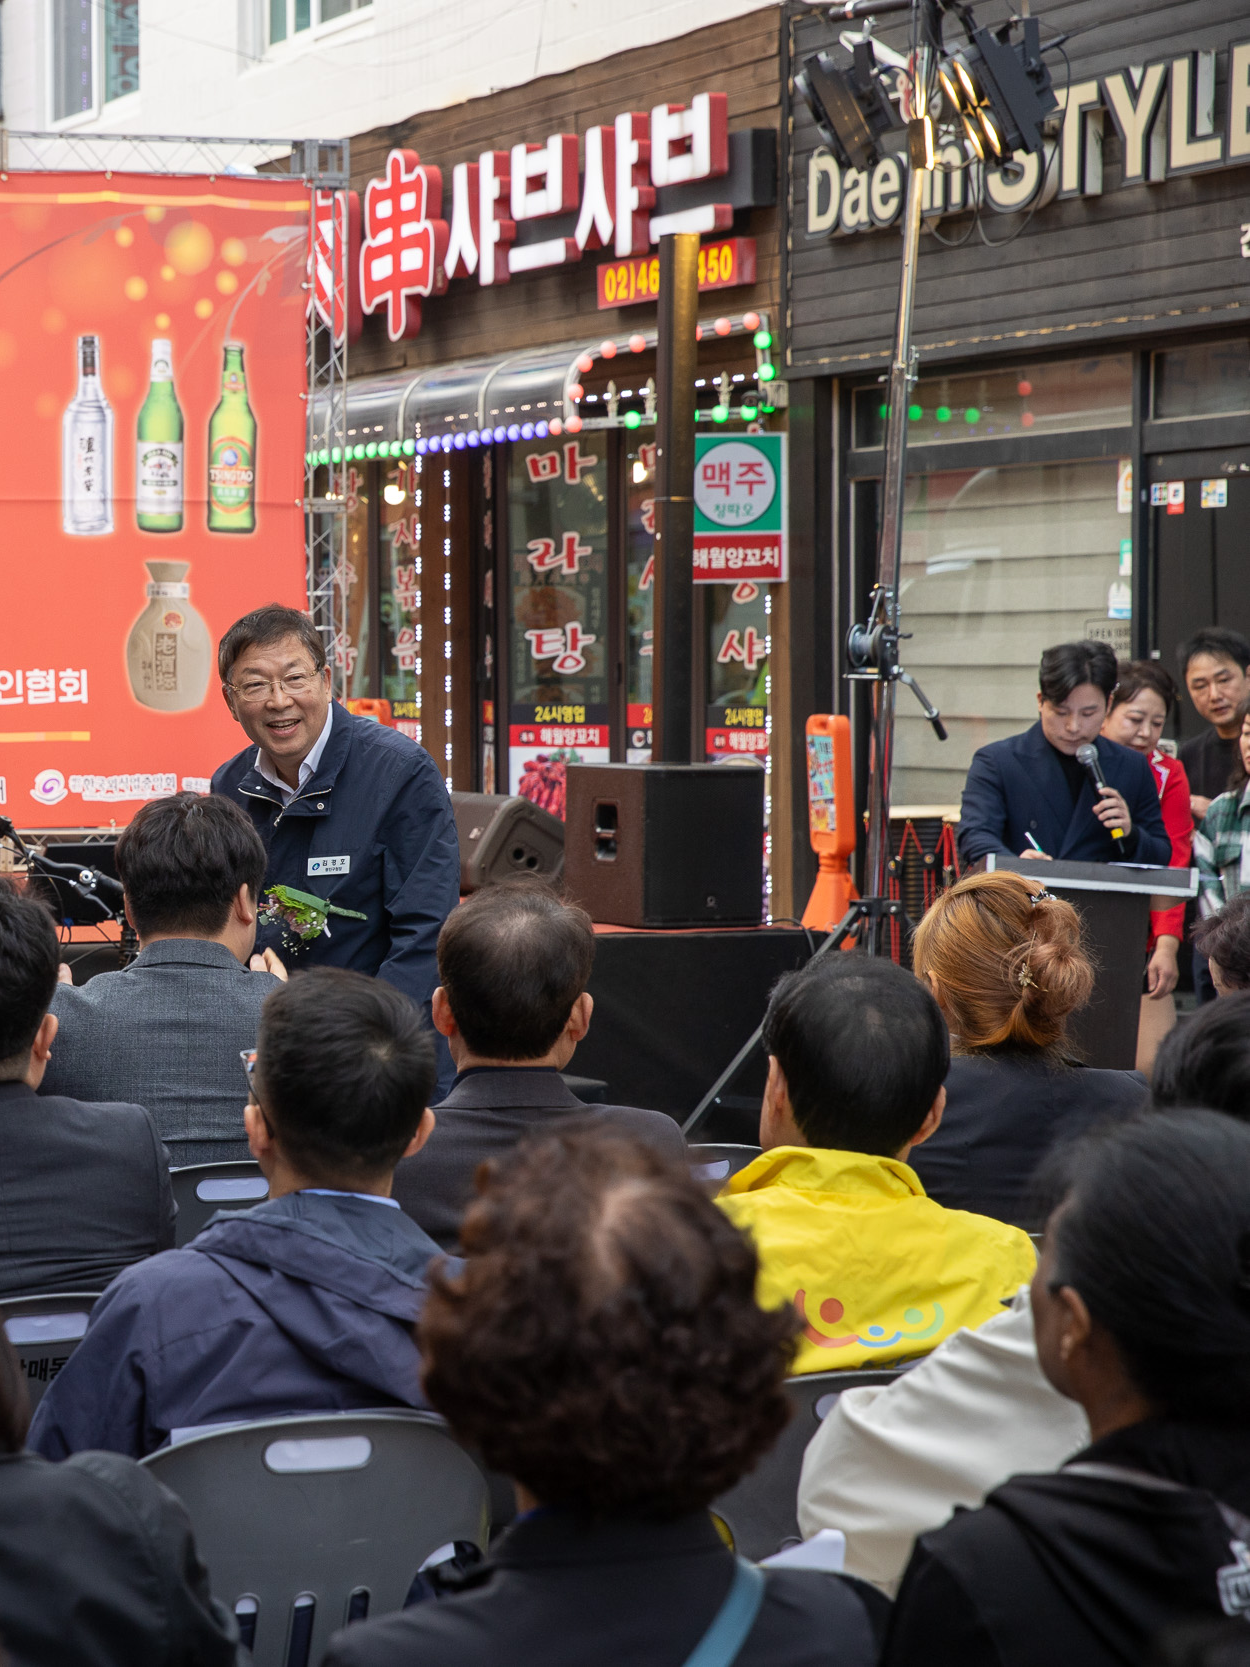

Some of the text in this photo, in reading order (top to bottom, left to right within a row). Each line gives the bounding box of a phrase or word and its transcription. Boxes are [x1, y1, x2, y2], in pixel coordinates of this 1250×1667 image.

[443, 92, 718, 286] 샤브샤브
[701, 461, 767, 497] 맥주
[524, 441, 598, 674] 마라탕
[534, 705, 586, 724] 24시영업
[540, 727, 600, 746] 해월양꼬치
